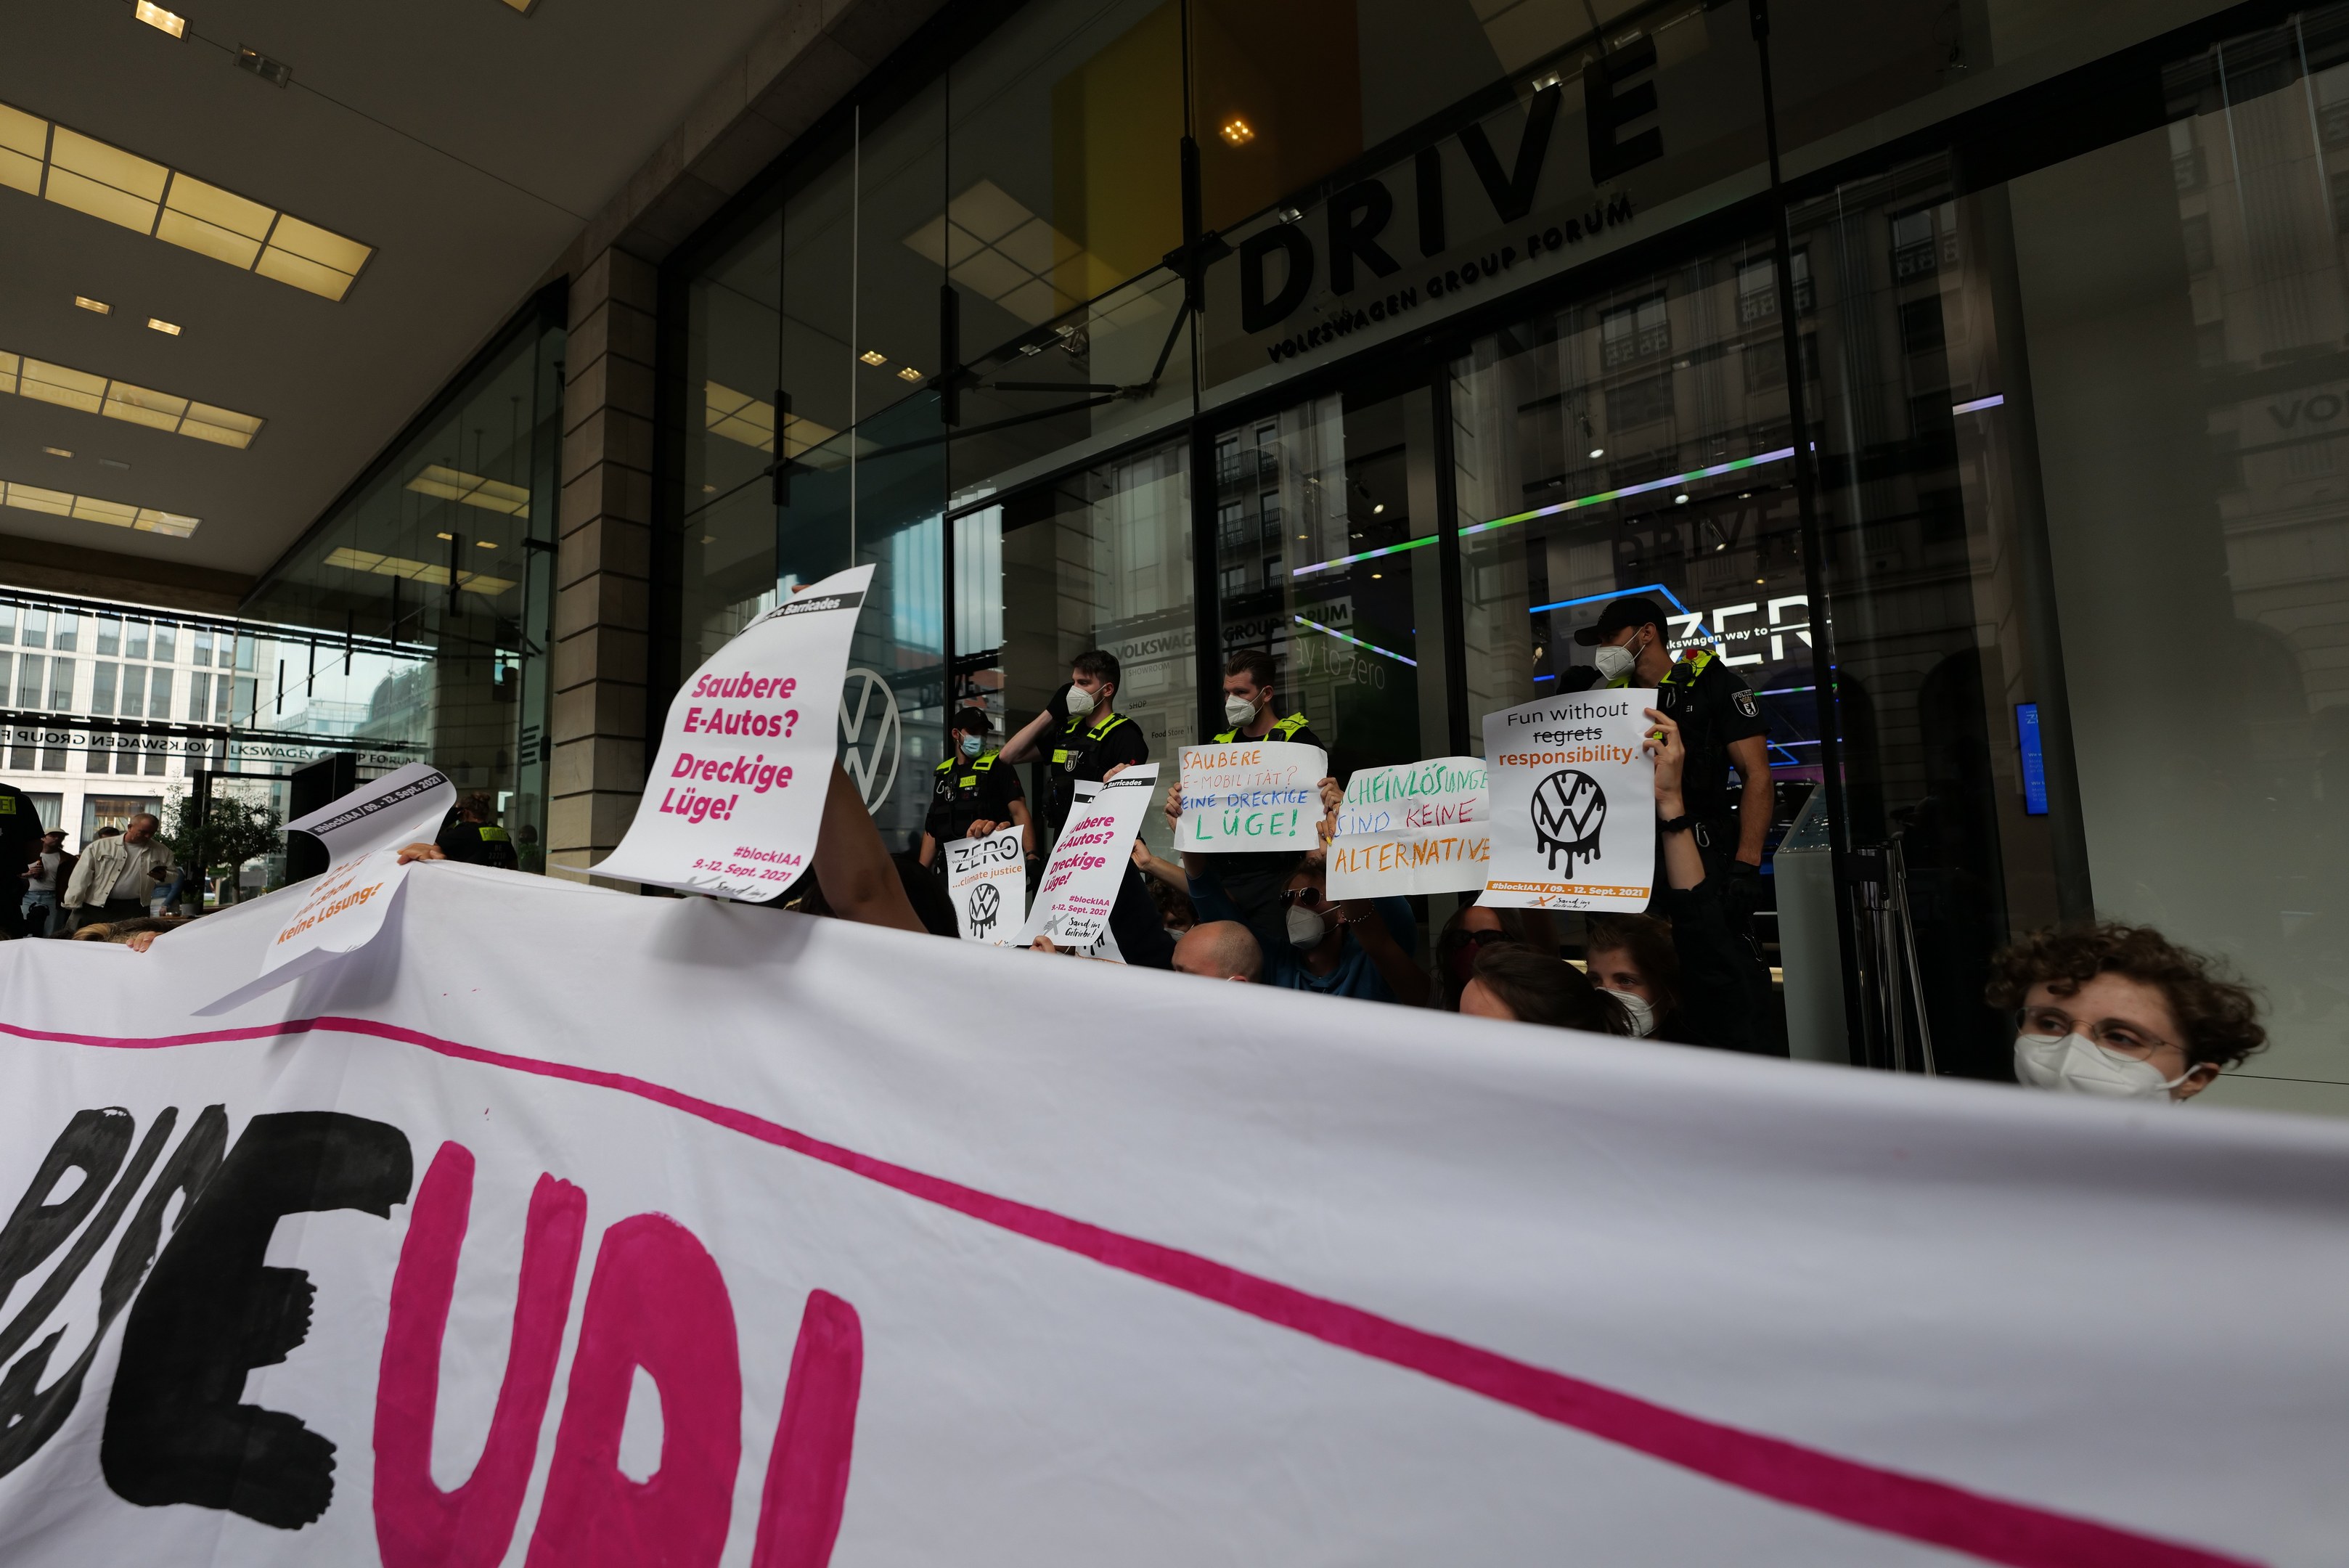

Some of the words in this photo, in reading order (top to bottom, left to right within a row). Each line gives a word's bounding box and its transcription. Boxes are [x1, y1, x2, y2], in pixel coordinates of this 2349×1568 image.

[1239, 33, 1663, 335] DRIVE
[1267, 286, 1418, 364] VOLKSWAGEN
[1426, 246, 1516, 298] GROUP
[1527, 197, 1633, 258] FORUM
[784, 597, 841, 615] Barricades
[1666, 595, 1813, 667] ZER
[1725, 629, 1750, 642] way
[1754, 627, 1768, 637] to
[1114, 632, 1195, 661] VOLKSWAG
[1128, 662, 1171, 677] SHOWROOM
[1320, 640, 1341, 675] to
[1348, 656, 1385, 690] zero
[691, 671, 797, 699] Saubere
[1129, 700, 1147, 710] SHOP
[1508, 711, 1543, 726] Fun
[1550, 701, 1629, 721] without
[683, 707, 799, 738] E-Autos?
[1151, 730, 1167, 739] Food
[1167, 727, 1185, 738] Store
[1533, 727, 1603, 746] regrets
[1183, 750, 1262, 770] SAUBERE
[1499, 744, 1639, 769] responsibility.
[671, 753, 793, 793] Dreckige
[1339, 763, 1487, 806] CHEINLÖSUNGE
[314, 812, 361, 833] #blockIAA
[419, 775, 441, 789] 2021
[659, 787, 739, 824] Lüge!
[1182, 793, 1217, 810] EINE
[1196, 808, 1298, 840] LÜGE!
[1334, 807, 1390, 838] SIND
[1406, 798, 1477, 828] KEINE
[1057, 831, 1114, 853] E-Autos?
[733, 846, 801, 867] #blockIAA
[955, 836, 1018, 873] ZERO
[1050, 852, 1106, 875] Dreckige
[724, 864, 756, 877] Sept.
[759, 869, 792, 882] 2021
[989, 865, 1022, 878] justice
[1043, 871, 1073, 893] Lüge!
[1069, 895, 1110, 907] #blockIAA
[1492, 883, 1541, 893] #blockIAA
[1588, 887, 1617, 897] Sept.
[316, 882, 384, 924] Lösung!
[1068, 905, 1088, 915] Sept.
[1090, 907, 1108, 916] 2021
[1065, 927, 1097, 938] Getriebe!
[1069, 917, 1090, 927] Sand
